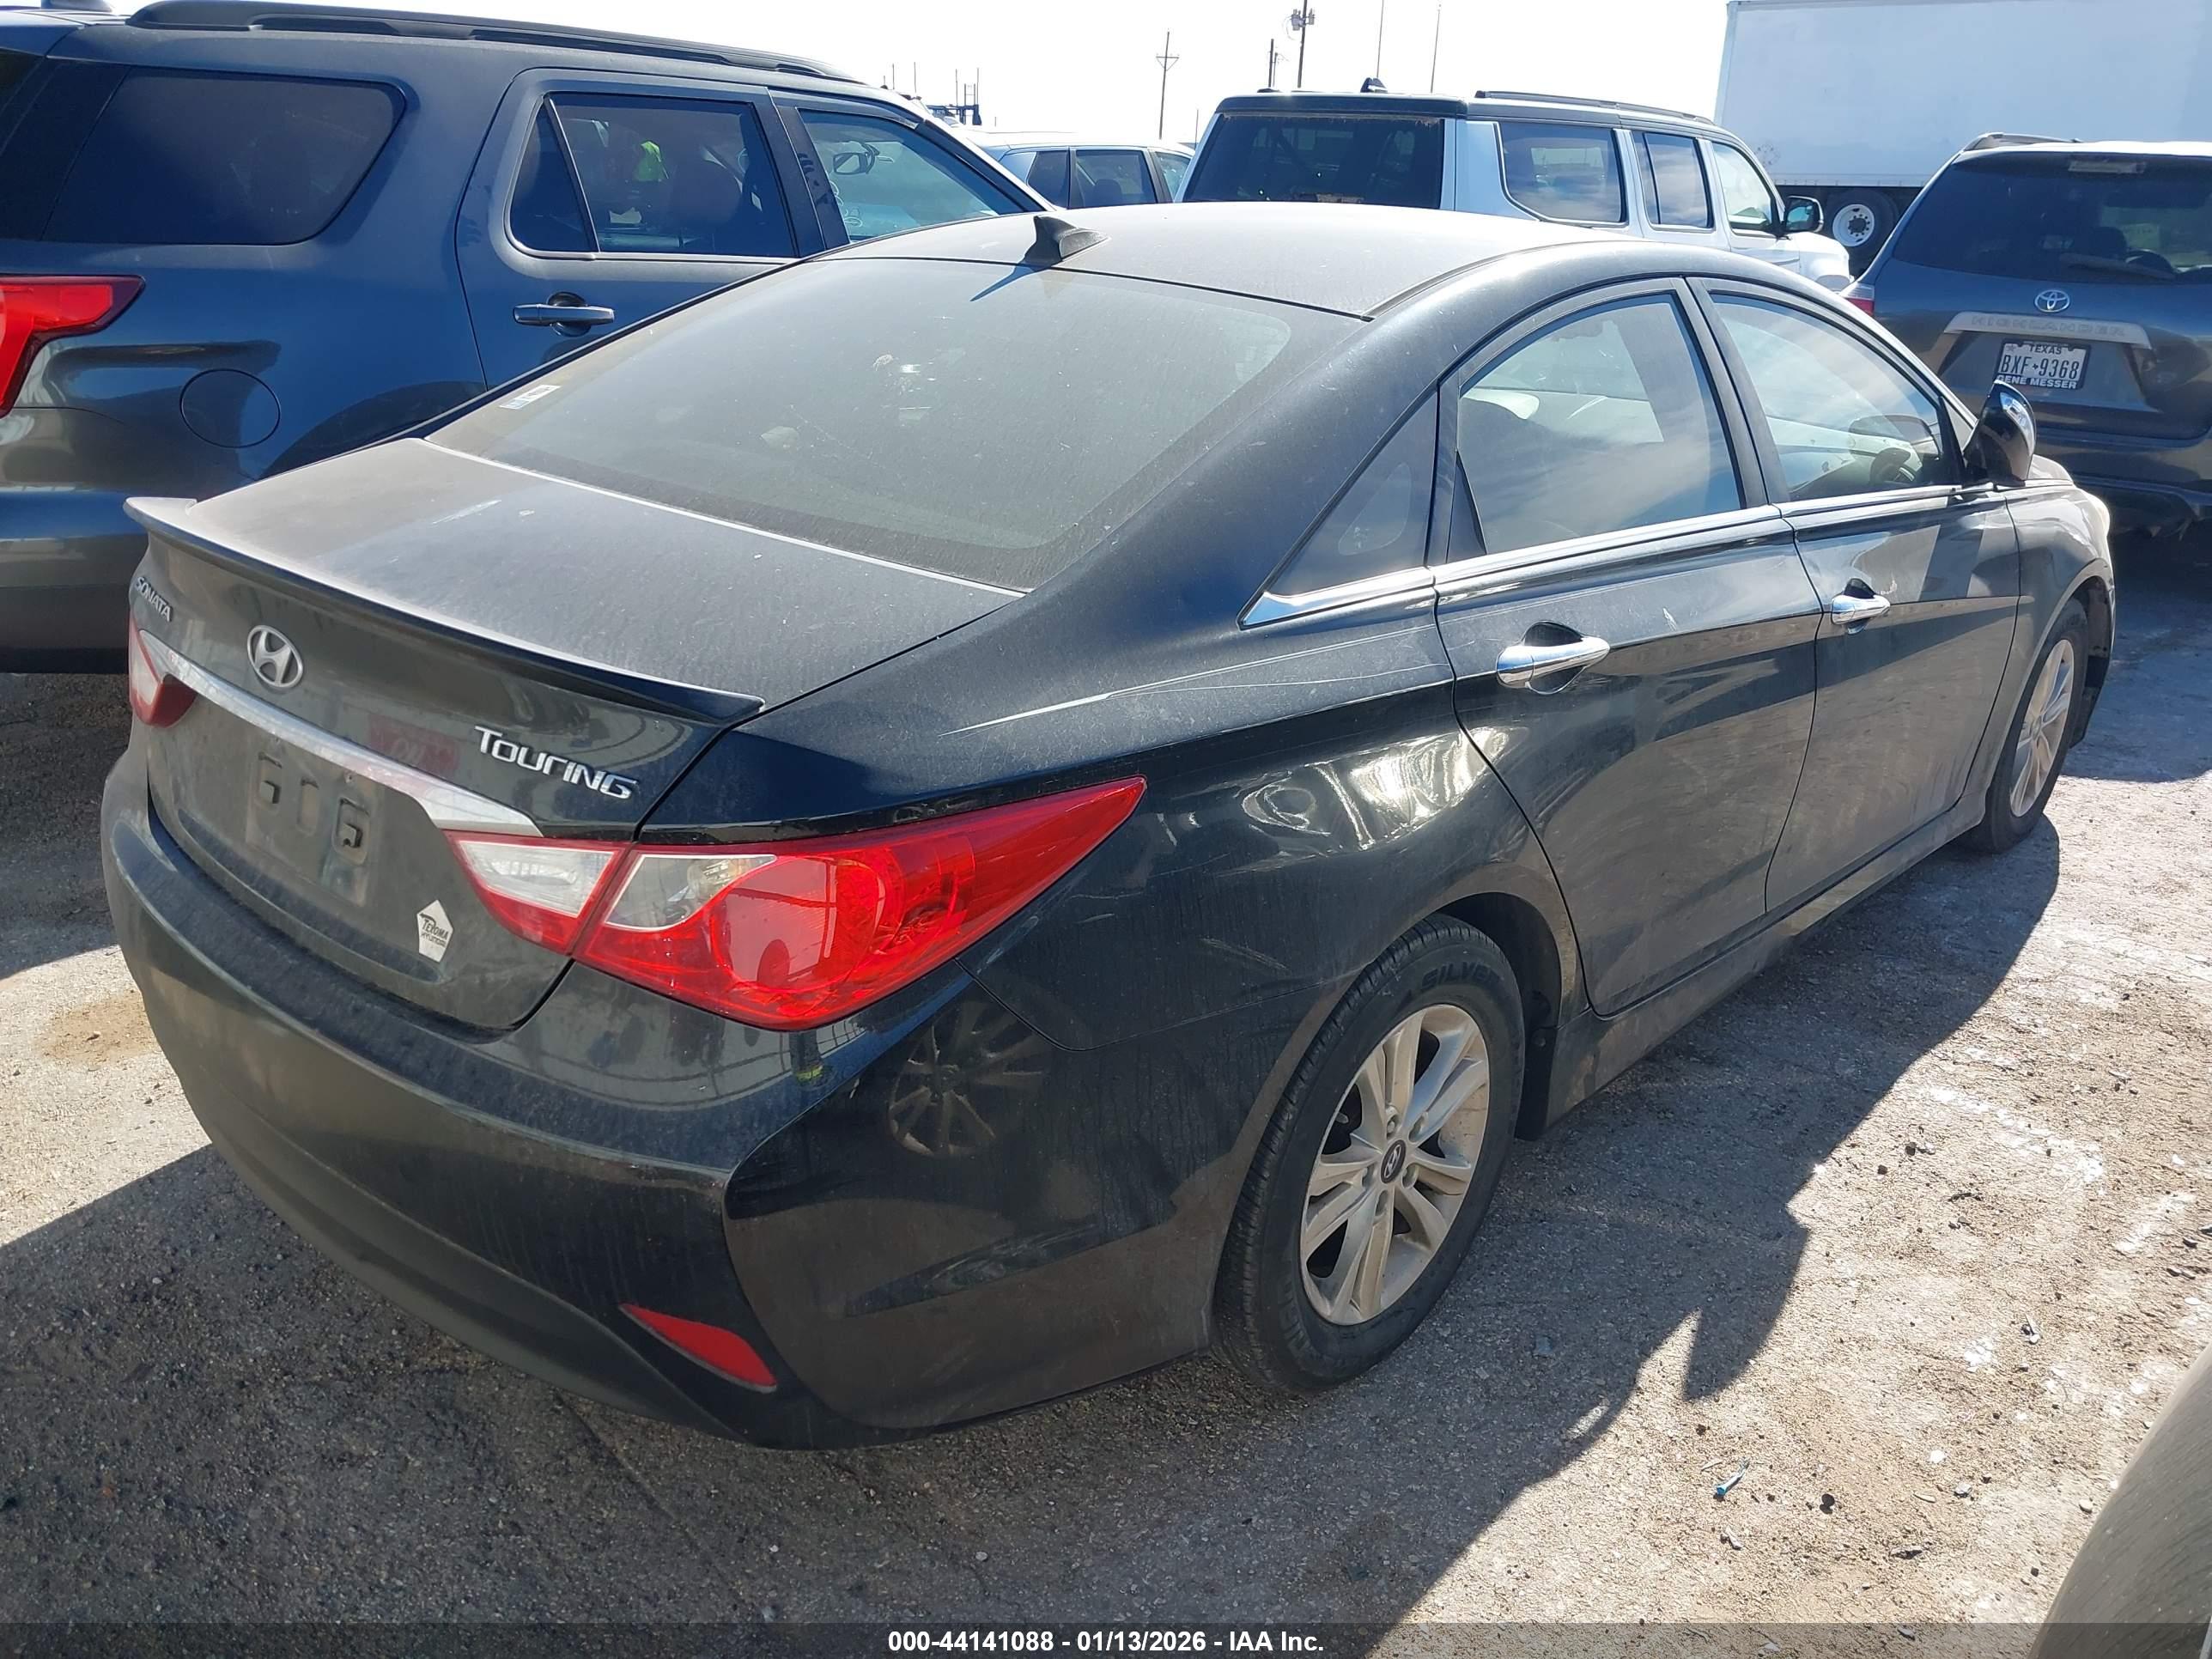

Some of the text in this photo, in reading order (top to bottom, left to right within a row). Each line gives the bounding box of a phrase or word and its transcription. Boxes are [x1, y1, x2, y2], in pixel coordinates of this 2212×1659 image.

[2029, 344, 2062, 355] TEXAS
[2001, 355, 2080, 380] BXF 9368
[1996, 374, 2077, 389] GENE MESSER
[135, 576, 172, 623] SONATA
